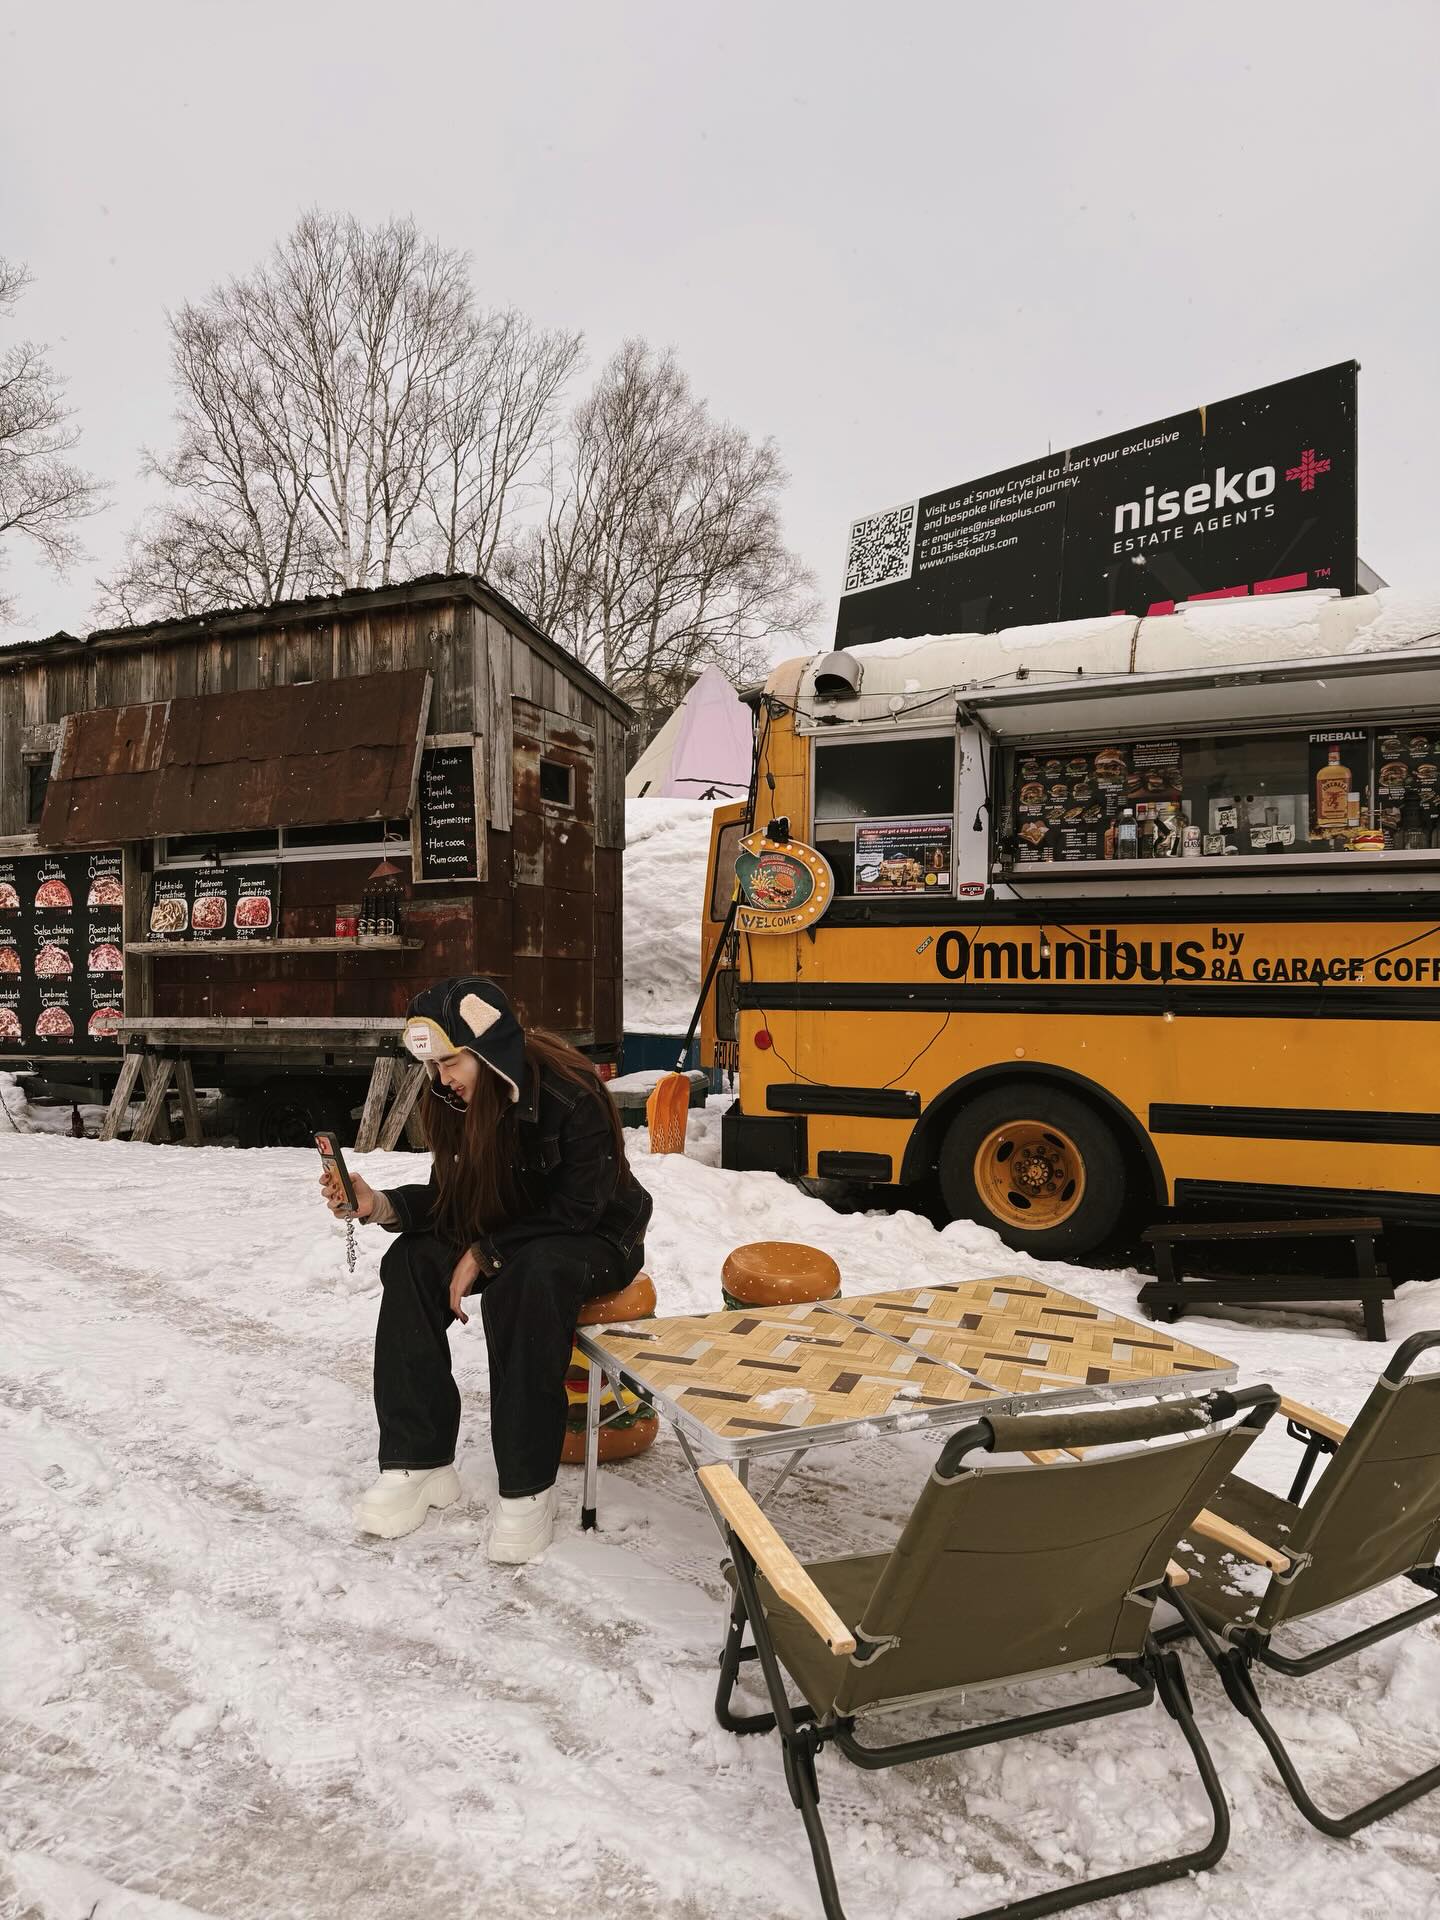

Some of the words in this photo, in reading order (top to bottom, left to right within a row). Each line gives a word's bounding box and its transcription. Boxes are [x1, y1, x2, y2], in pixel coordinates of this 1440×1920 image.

[925, 503, 947, 518] Visit
[949, 499, 961, 510] us
[963, 494, 975, 509] at
[976, 485, 1005, 502] Snow
[1007, 470, 1046, 492] Crystal
[1048, 467, 1060, 479] to
[1062, 457, 1091, 474] start
[1093, 450, 1119, 467] your
[1122, 431, 1180, 456] exclusive
[923, 516, 941, 531] and
[944, 503, 987, 525] bespoke
[990, 488, 1033, 511] lifestyle
[1035, 475, 1080, 499] journey.
[1114, 466, 1276, 534] niseko
[922, 537, 930, 546] e:
[932, 500, 1056, 544] enquiries@nisekoplus.com
[1113, 526, 1184, 554] ESTATE
[1194, 504, 1275, 535] AGENTS
[920, 549, 927, 559] t:
[930, 529, 997, 556] 0136-55-5273
[919, 536, 1018, 571] www.nisekoplus.com
[1315, 567, 1331, 578] TM
[1309, 731, 1367, 743] FIREBALL
[441, 757, 458, 765] Drink
[425, 770, 446, 782] Beer
[426, 785, 453, 798] Tequila
[429, 837, 444, 849] Hot
[445, 839, 466, 847] cocoa
[44, 859, 60, 870] Ham
[429, 854, 446, 865] Rum
[447, 855, 469, 863] cocoa
[37, 870, 67, 883] Quesadilla
[88, 866, 121, 879] Quesadilla
[154, 880, 184, 890] Hokkaido
[194, 879, 223, 889] Mushroom
[741, 914, 797, 929] WELCOME
[33, 924, 51, 935] Salsa
[52, 924, 74, 934] chicken
[88, 923, 106, 935] Roast
[107, 923, 122, 935] pork
[37, 935, 69, 946] Quesadilla
[88, 934, 120, 945] Quesadilla
[1212, 928, 1244, 955] by
[935, 929, 1206, 981] Omunibus
[1211, 958, 1244, 981] 8A
[1253, 958, 1364, 981] GARAGE
[41, 998, 70, 1008] Quesadilla
